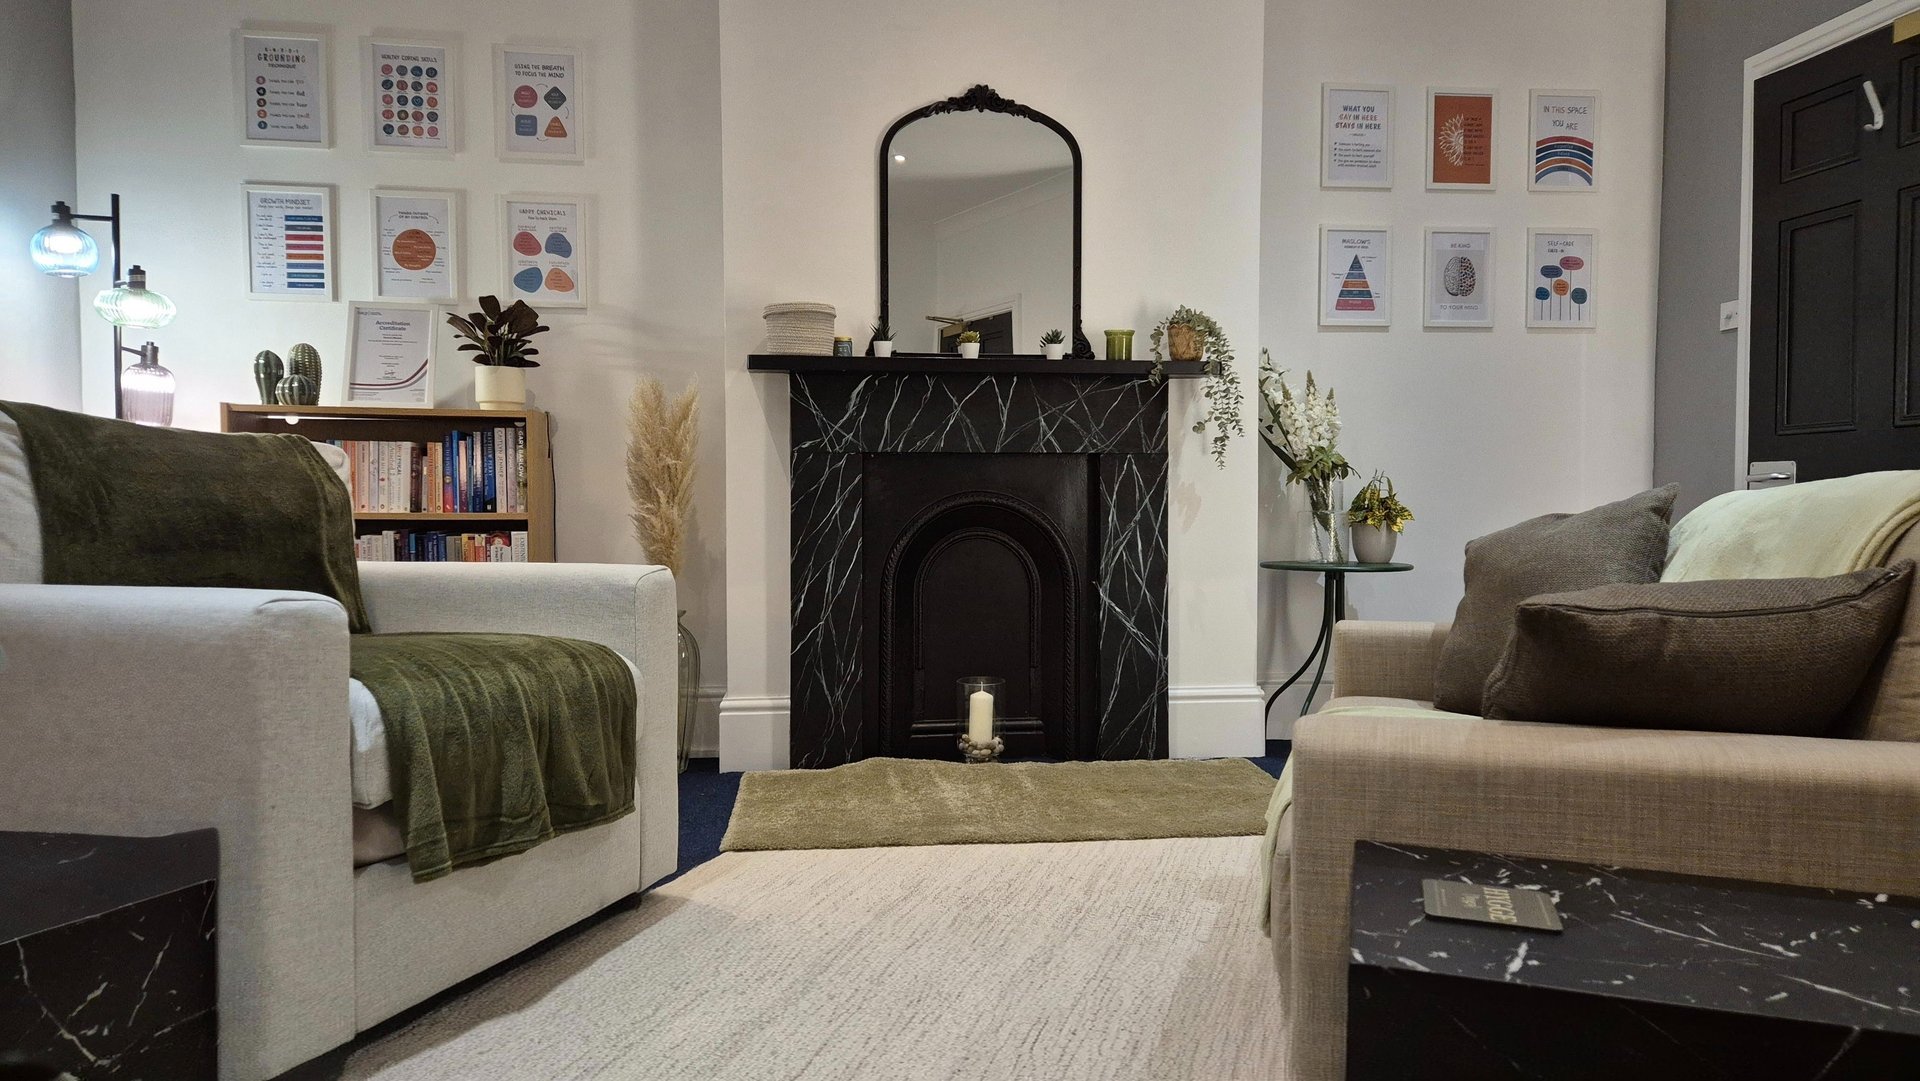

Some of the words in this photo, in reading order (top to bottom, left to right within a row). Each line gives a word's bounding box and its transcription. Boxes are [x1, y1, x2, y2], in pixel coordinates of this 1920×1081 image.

[257, 53, 306, 63] GROUNDING
[1552, 106, 1565, 114] THIS
[1483, 887, 1517, 922] HYGGE
